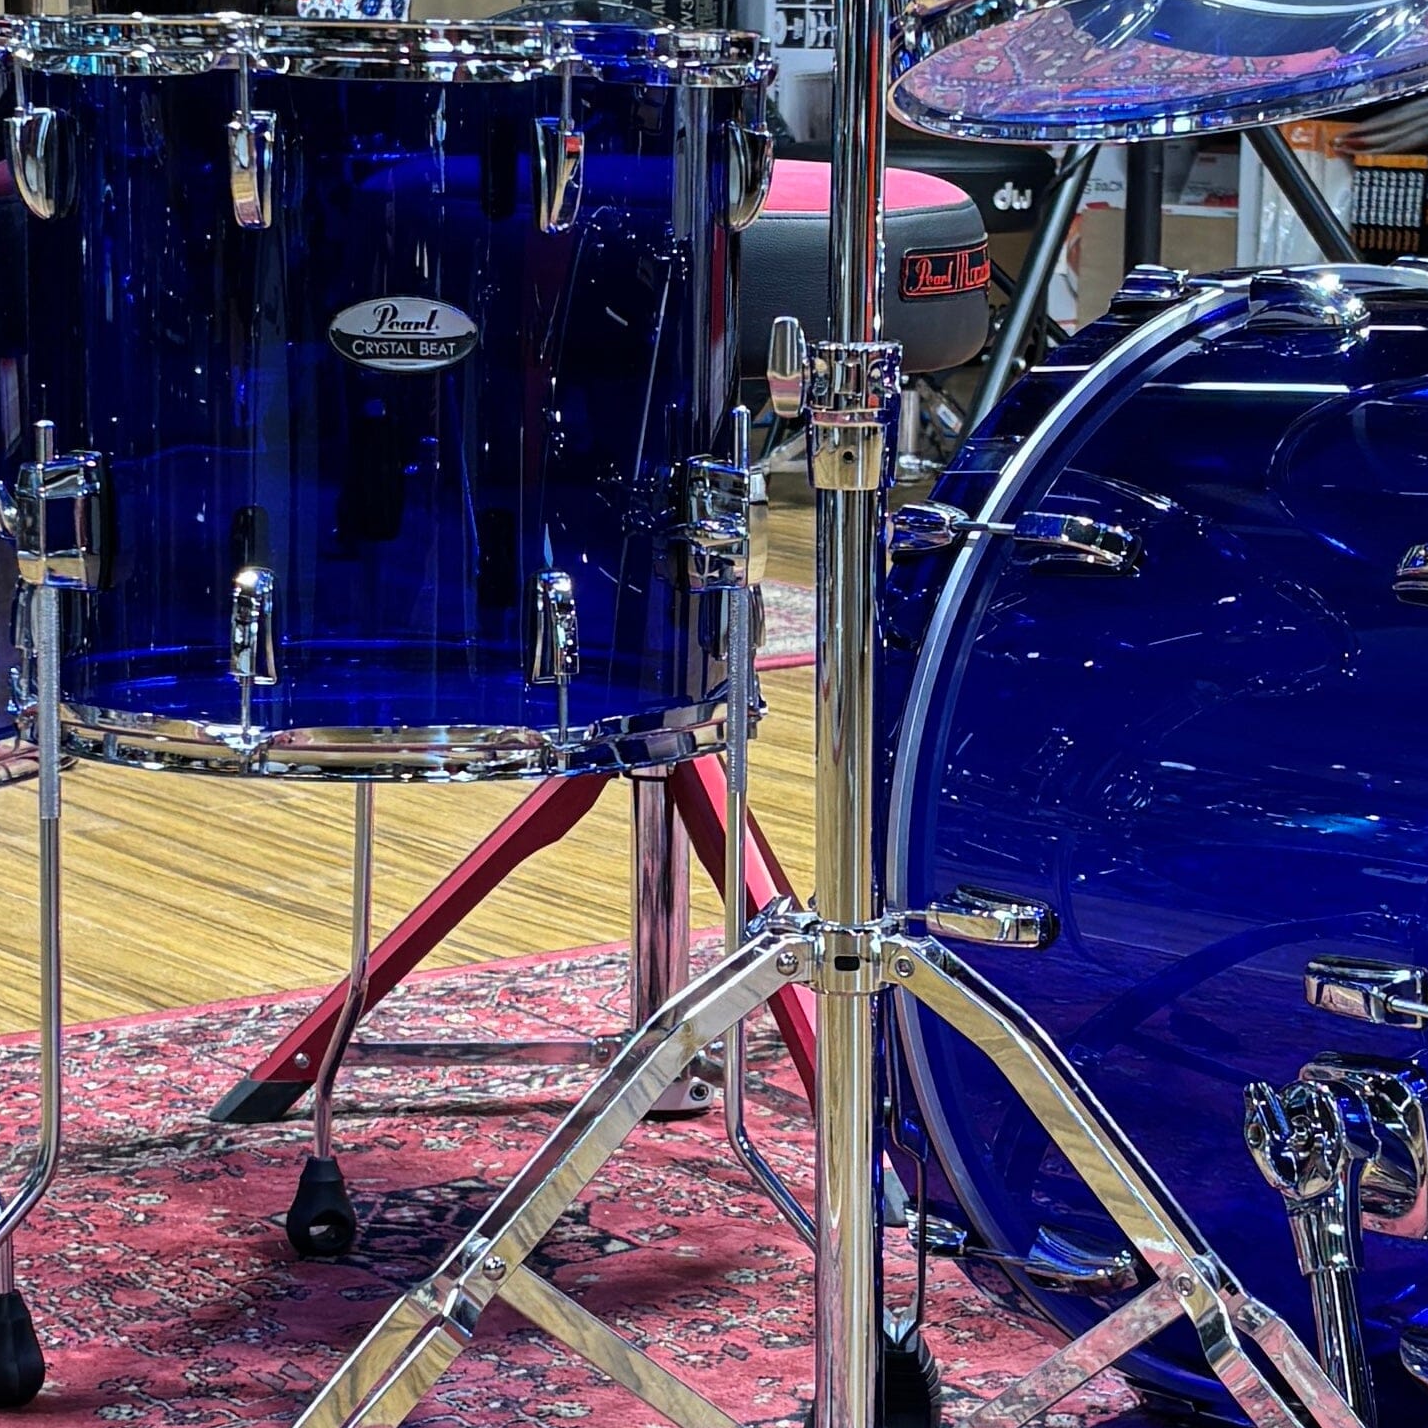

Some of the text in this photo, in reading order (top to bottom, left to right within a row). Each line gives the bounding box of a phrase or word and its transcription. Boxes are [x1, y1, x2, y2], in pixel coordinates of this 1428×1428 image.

[992, 181, 1033, 211] dw
[909, 257, 954, 292] Pearl
[363, 302, 439, 336] Pearl
[352, 340, 457, 356] CRYSTAL BEAT
